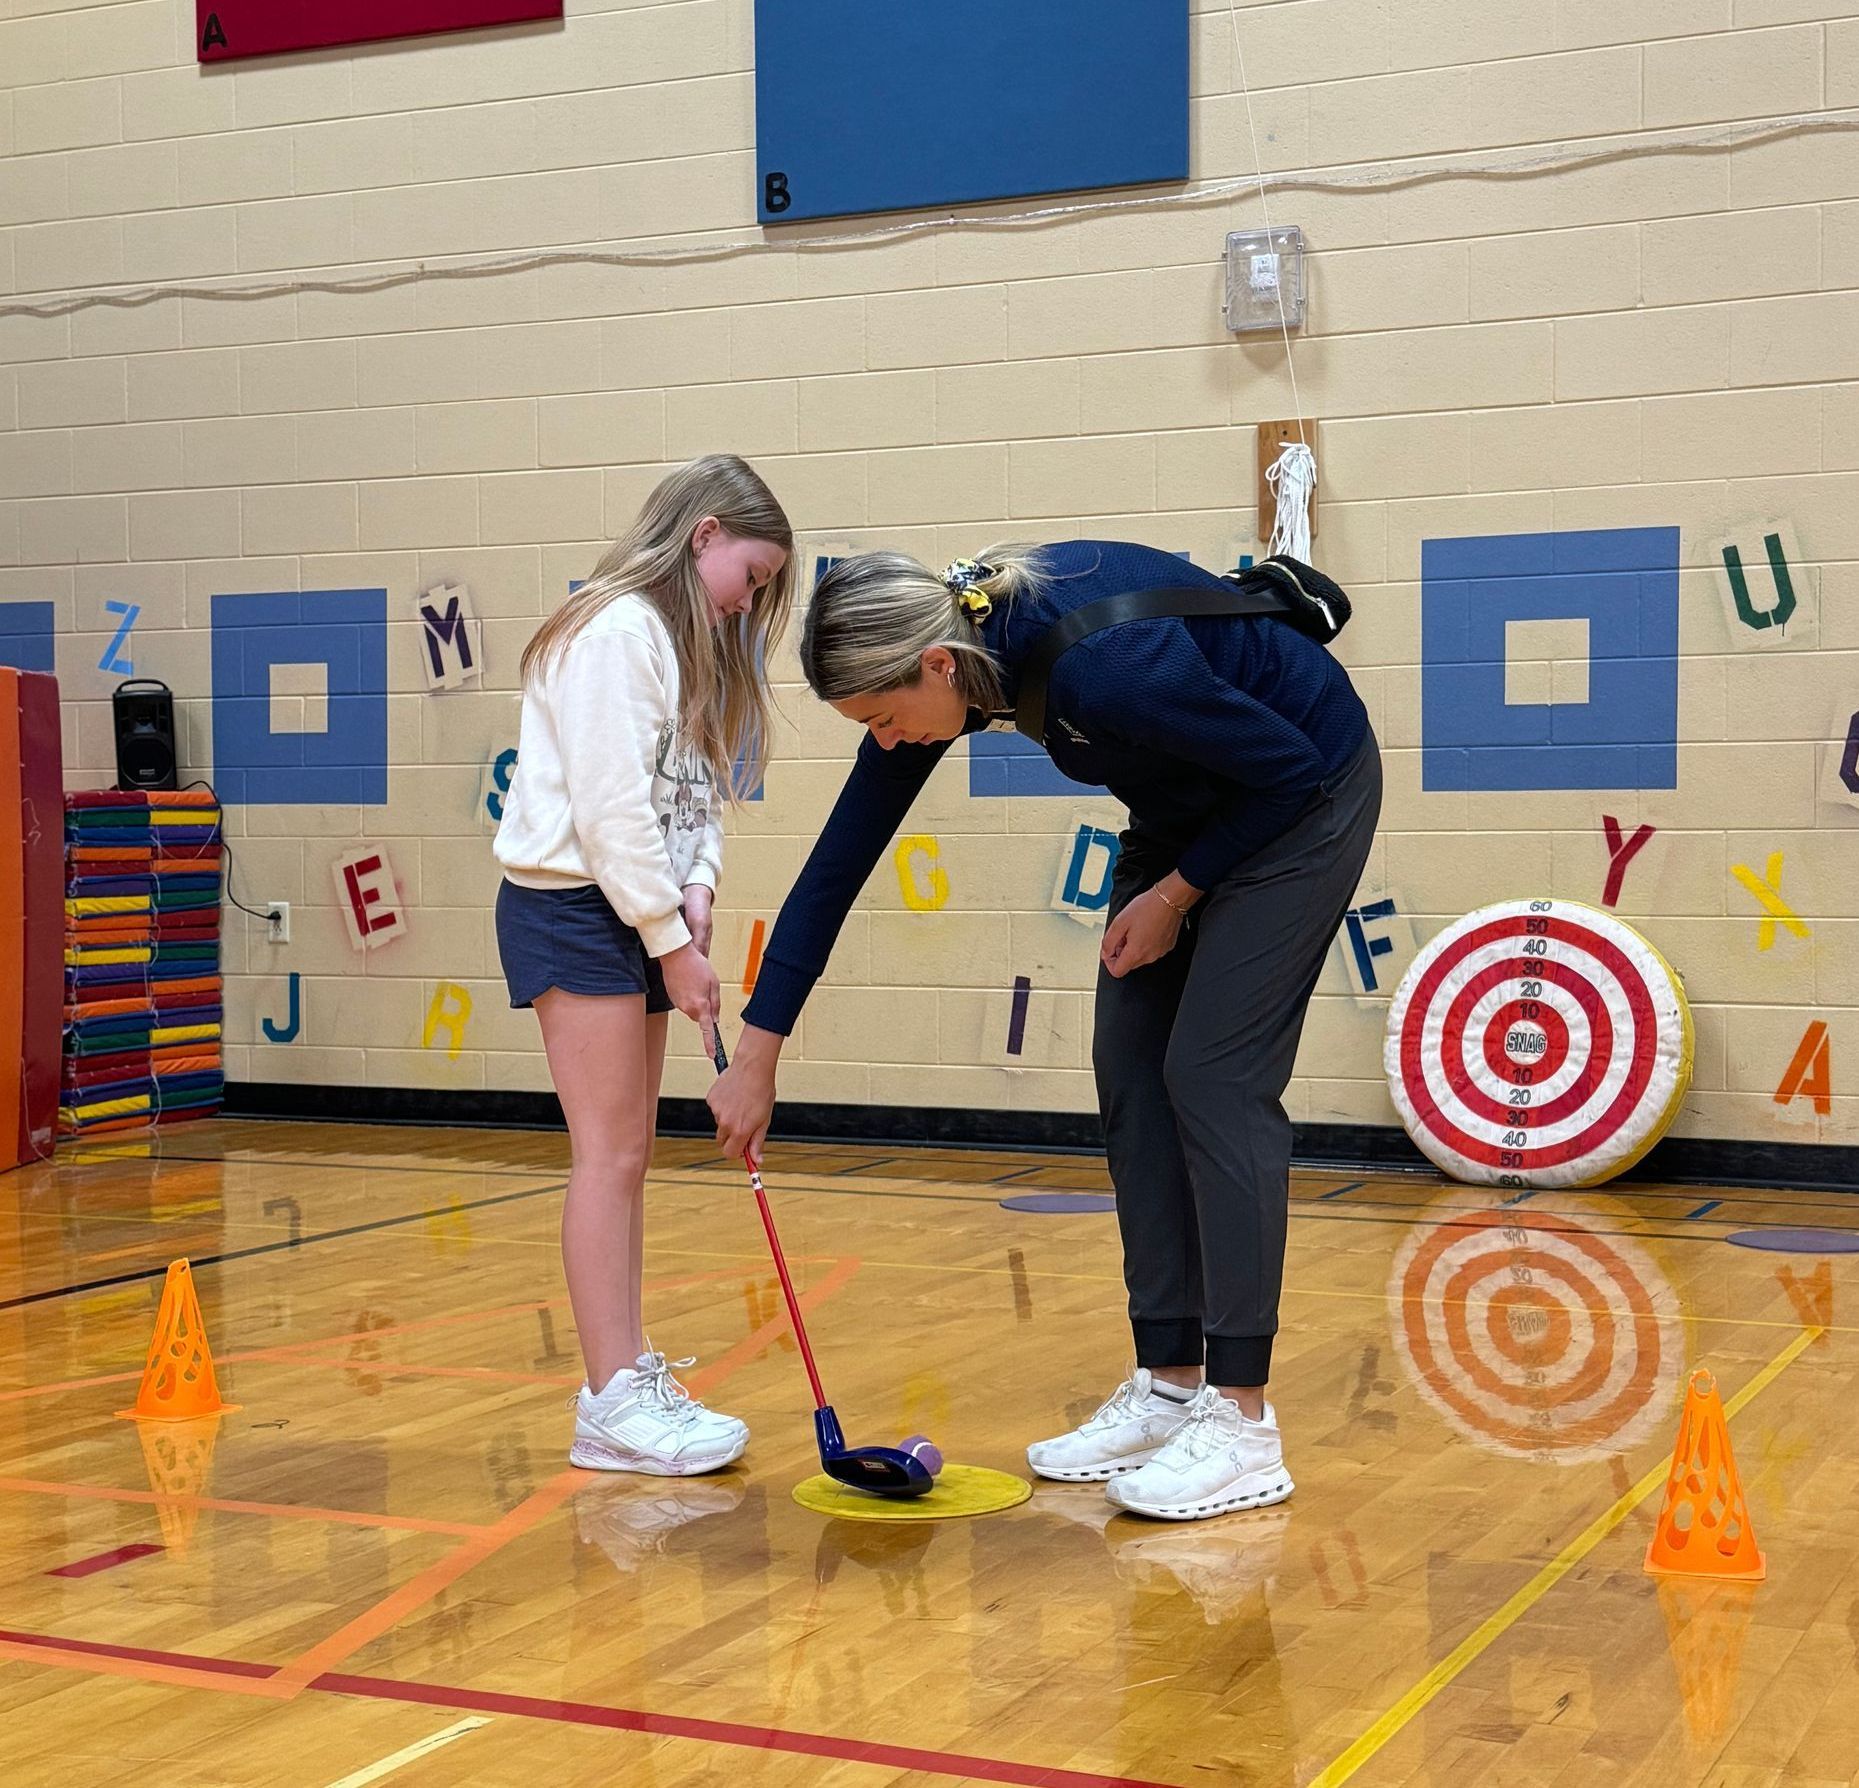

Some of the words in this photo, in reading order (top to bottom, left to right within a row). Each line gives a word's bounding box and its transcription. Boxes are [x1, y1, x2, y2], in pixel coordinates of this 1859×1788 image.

[202, 12, 228, 53] A
[765, 171, 791, 213] B
[1722, 532, 1797, 632] U
[98, 599, 141, 676] Z
[420, 596, 473, 678] M
[894, 833, 949, 912] G
[1061, 823, 1121, 910] D
[1601, 814, 1657, 908] Y
[342, 854, 397, 937] E
[1529, 900, 1552, 912] 60
[1730, 851, 1811, 952] X
[1344, 898, 1397, 992] F
[1525, 918, 1549, 934] 50
[1522, 938, 1548, 956] 40
[1521, 960, 1545, 976] 30
[262, 972, 300, 1043] J
[1520, 980, 1543, 998] 20
[423, 981, 473, 1062] R
[1519, 1002, 1540, 1019] 10
[1506, 1031, 1548, 1054] SNAG
[1512, 1067, 1533, 1084] 10
[1773, 1019, 1831, 1116] A
[1508, 1088, 1532, 1105] 20
[1505, 1109, 1529, 1127] 30
[1499, 1151, 1524, 1168] 50
[1501, 1130, 1528, 1148] 40
